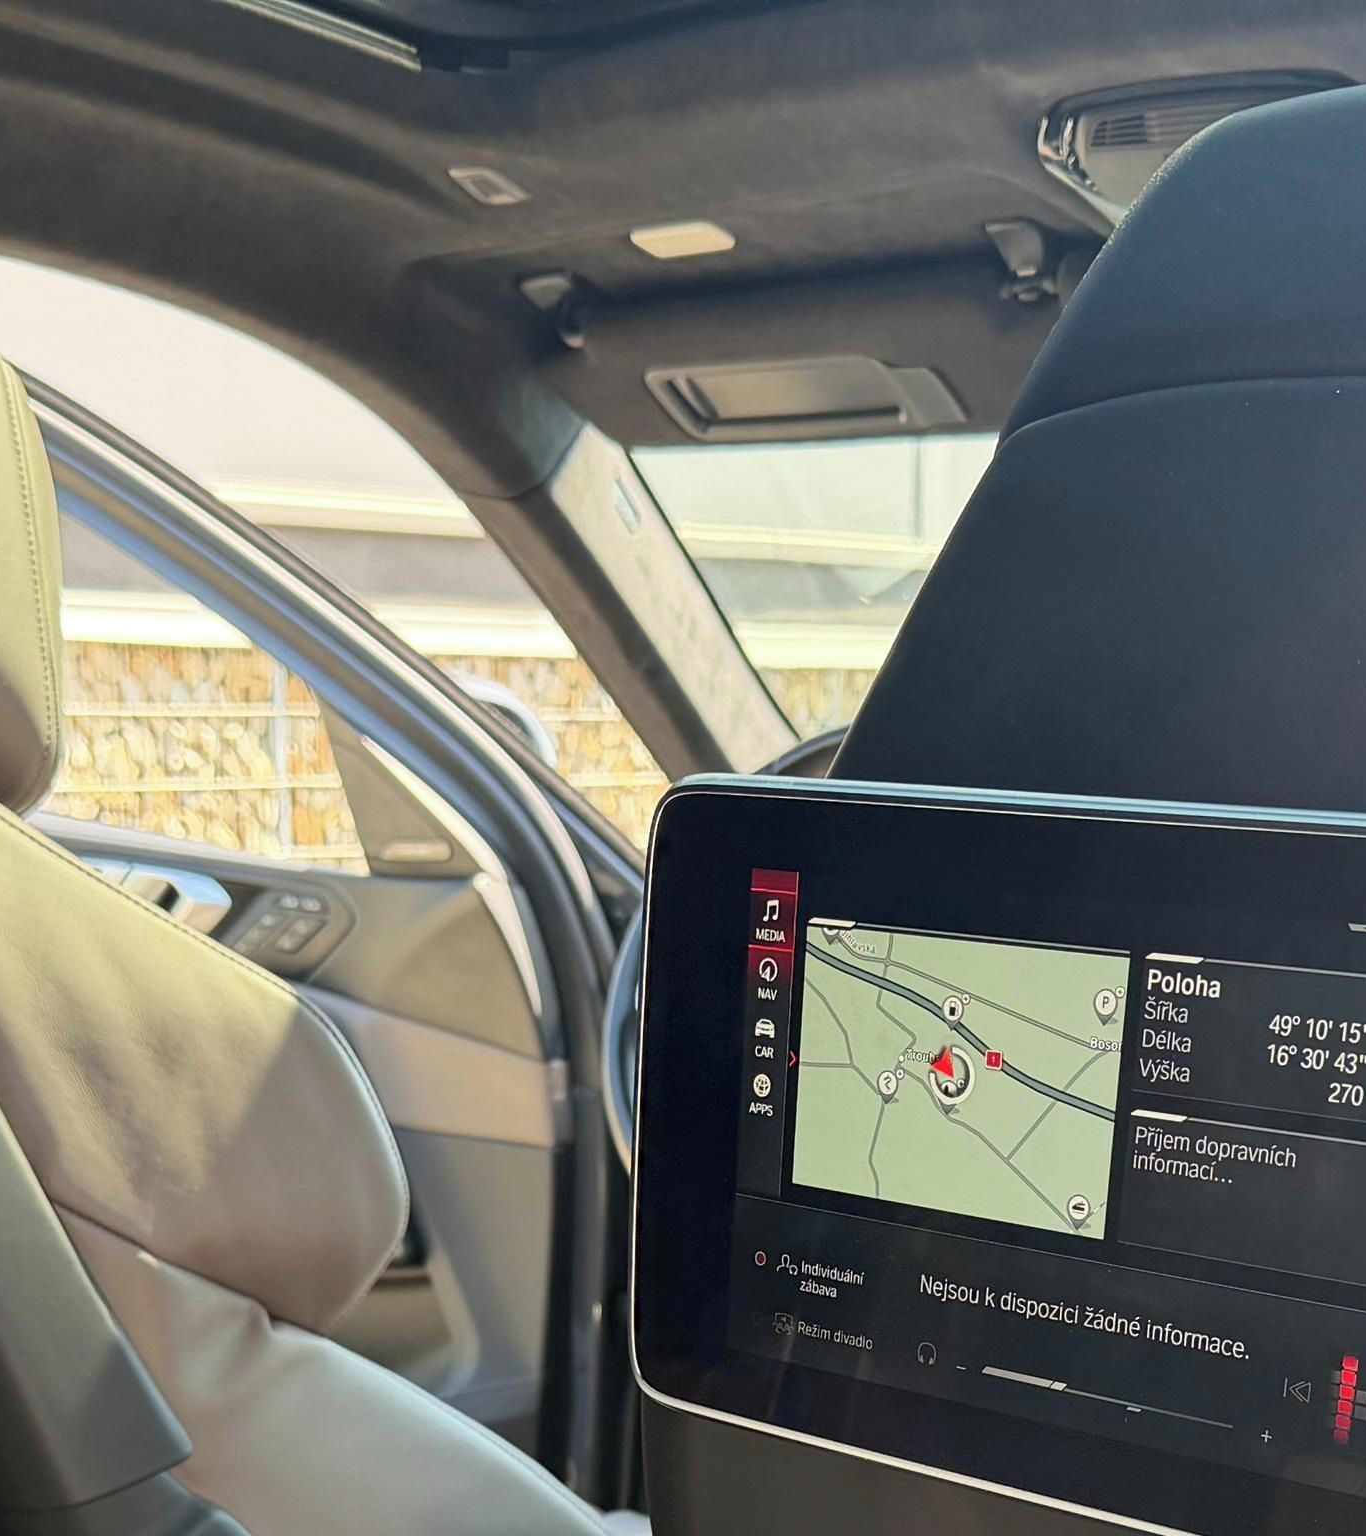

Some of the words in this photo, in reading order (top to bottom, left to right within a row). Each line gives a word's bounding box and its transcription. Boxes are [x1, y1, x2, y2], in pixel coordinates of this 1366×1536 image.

[755, 928, 786, 943] MEDIA
[757, 987, 778, 1001] NAV
[1146, 968, 1222, 998] Poloha
[1143, 996, 1190, 1024] Šířka
[754, 1046, 774, 1059] CAR
[1141, 1028, 1192, 1053] Délka
[1139, 1057, 1191, 1083] Výška
[1327, 1082, 1364, 1106] 270
[748, 1102, 774, 1117] APPS
[1135, 1126, 1190, 1153] Příjem
[1195, 1135, 1297, 1168] dopravních
[801, 1260, 865, 1286] Individuální
[799, 1279, 837, 1298] zábava
[919, 1274, 980, 1304] Nejsou
[984, 1287, 996, 1308] k
[1000, 1291, 1079, 1325] dispozici
[1083, 1306, 1140, 1337] žádné
[1145, 1319, 1250, 1361] informace.
[797, 1320, 831, 1341] Režim
[833, 1330, 873, 1350] divadlo
